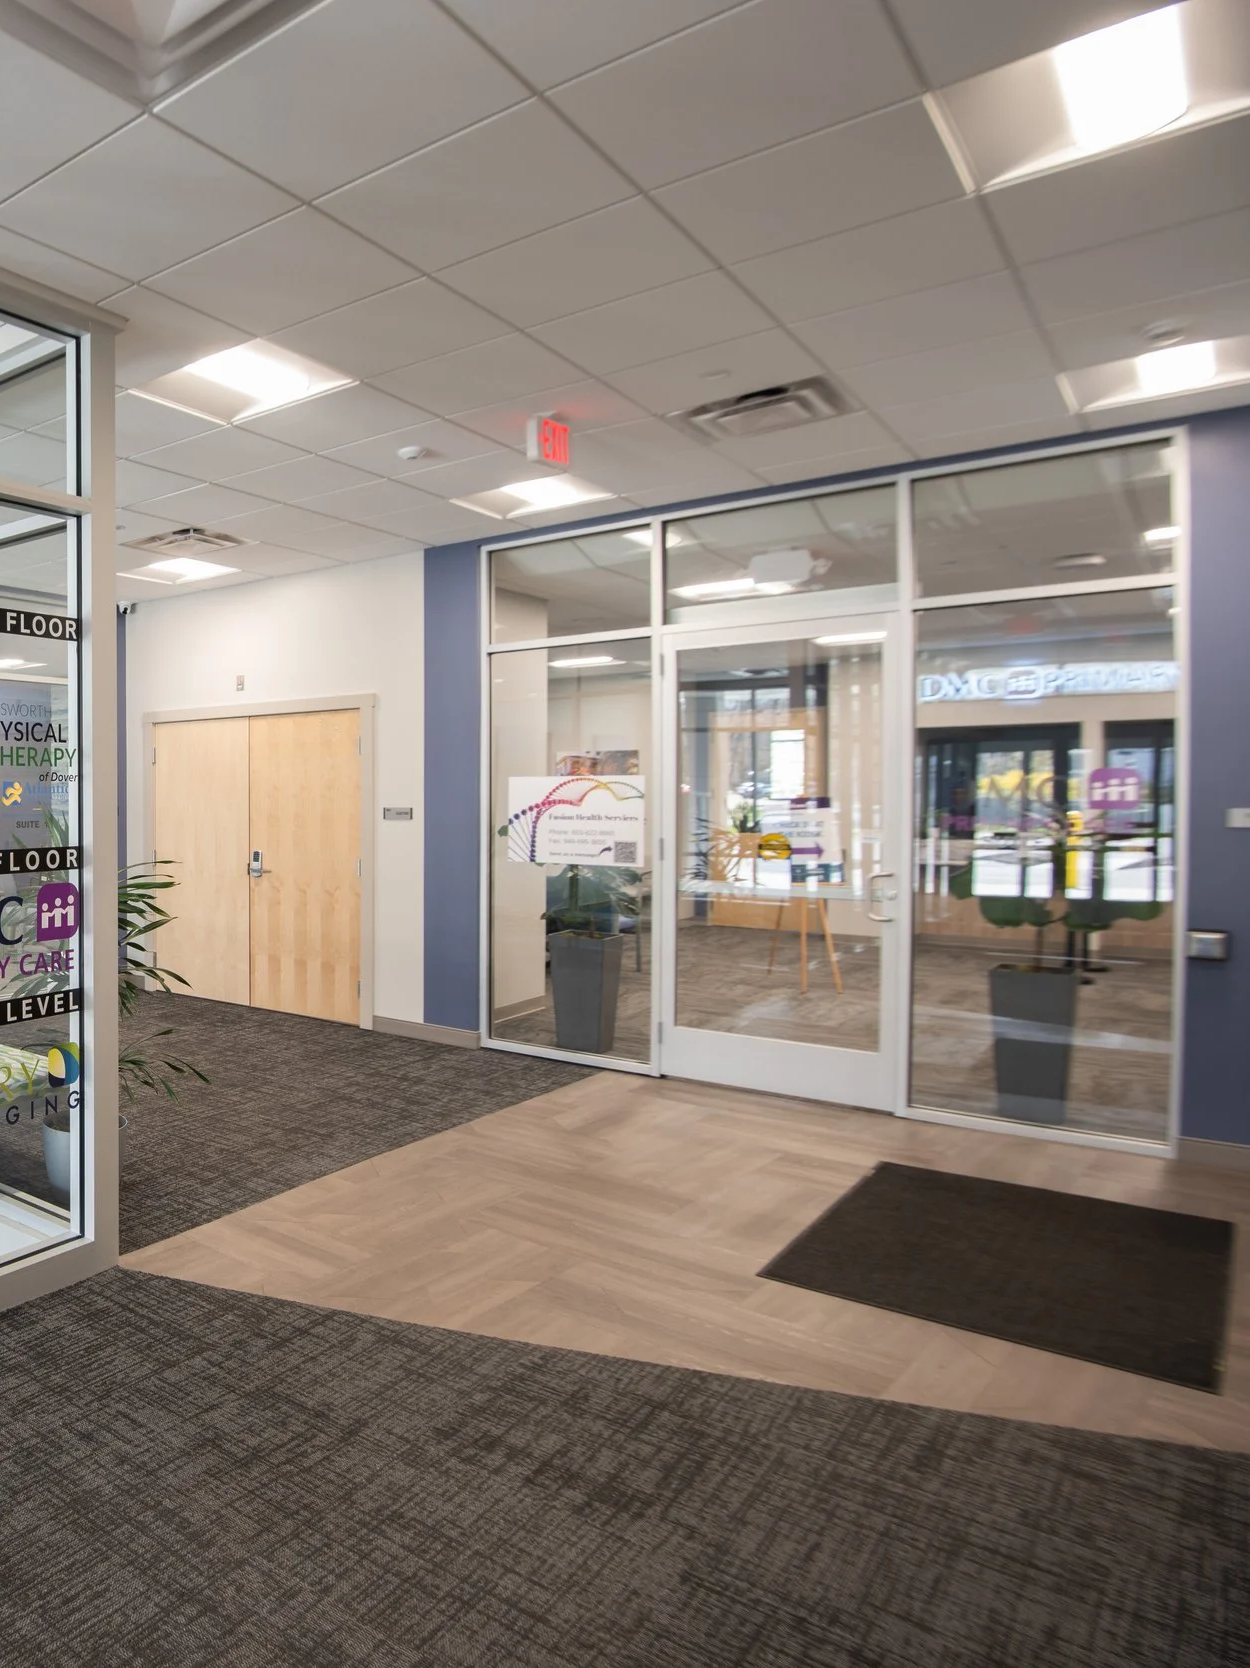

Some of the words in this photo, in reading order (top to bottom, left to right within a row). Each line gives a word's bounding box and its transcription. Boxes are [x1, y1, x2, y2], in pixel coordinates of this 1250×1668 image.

[6, 611, 78, 640] FLOOR
[918, 672, 999, 701] DMC
[39, 772, 50, 783] of
[50, 772, 78, 783] Dover
[16, 820, 41, 829] SUITE
[575, 813, 603, 821] Health
[19, 949, 75, 977] CARE
[6, 991, 79, 1021] LEVEL
